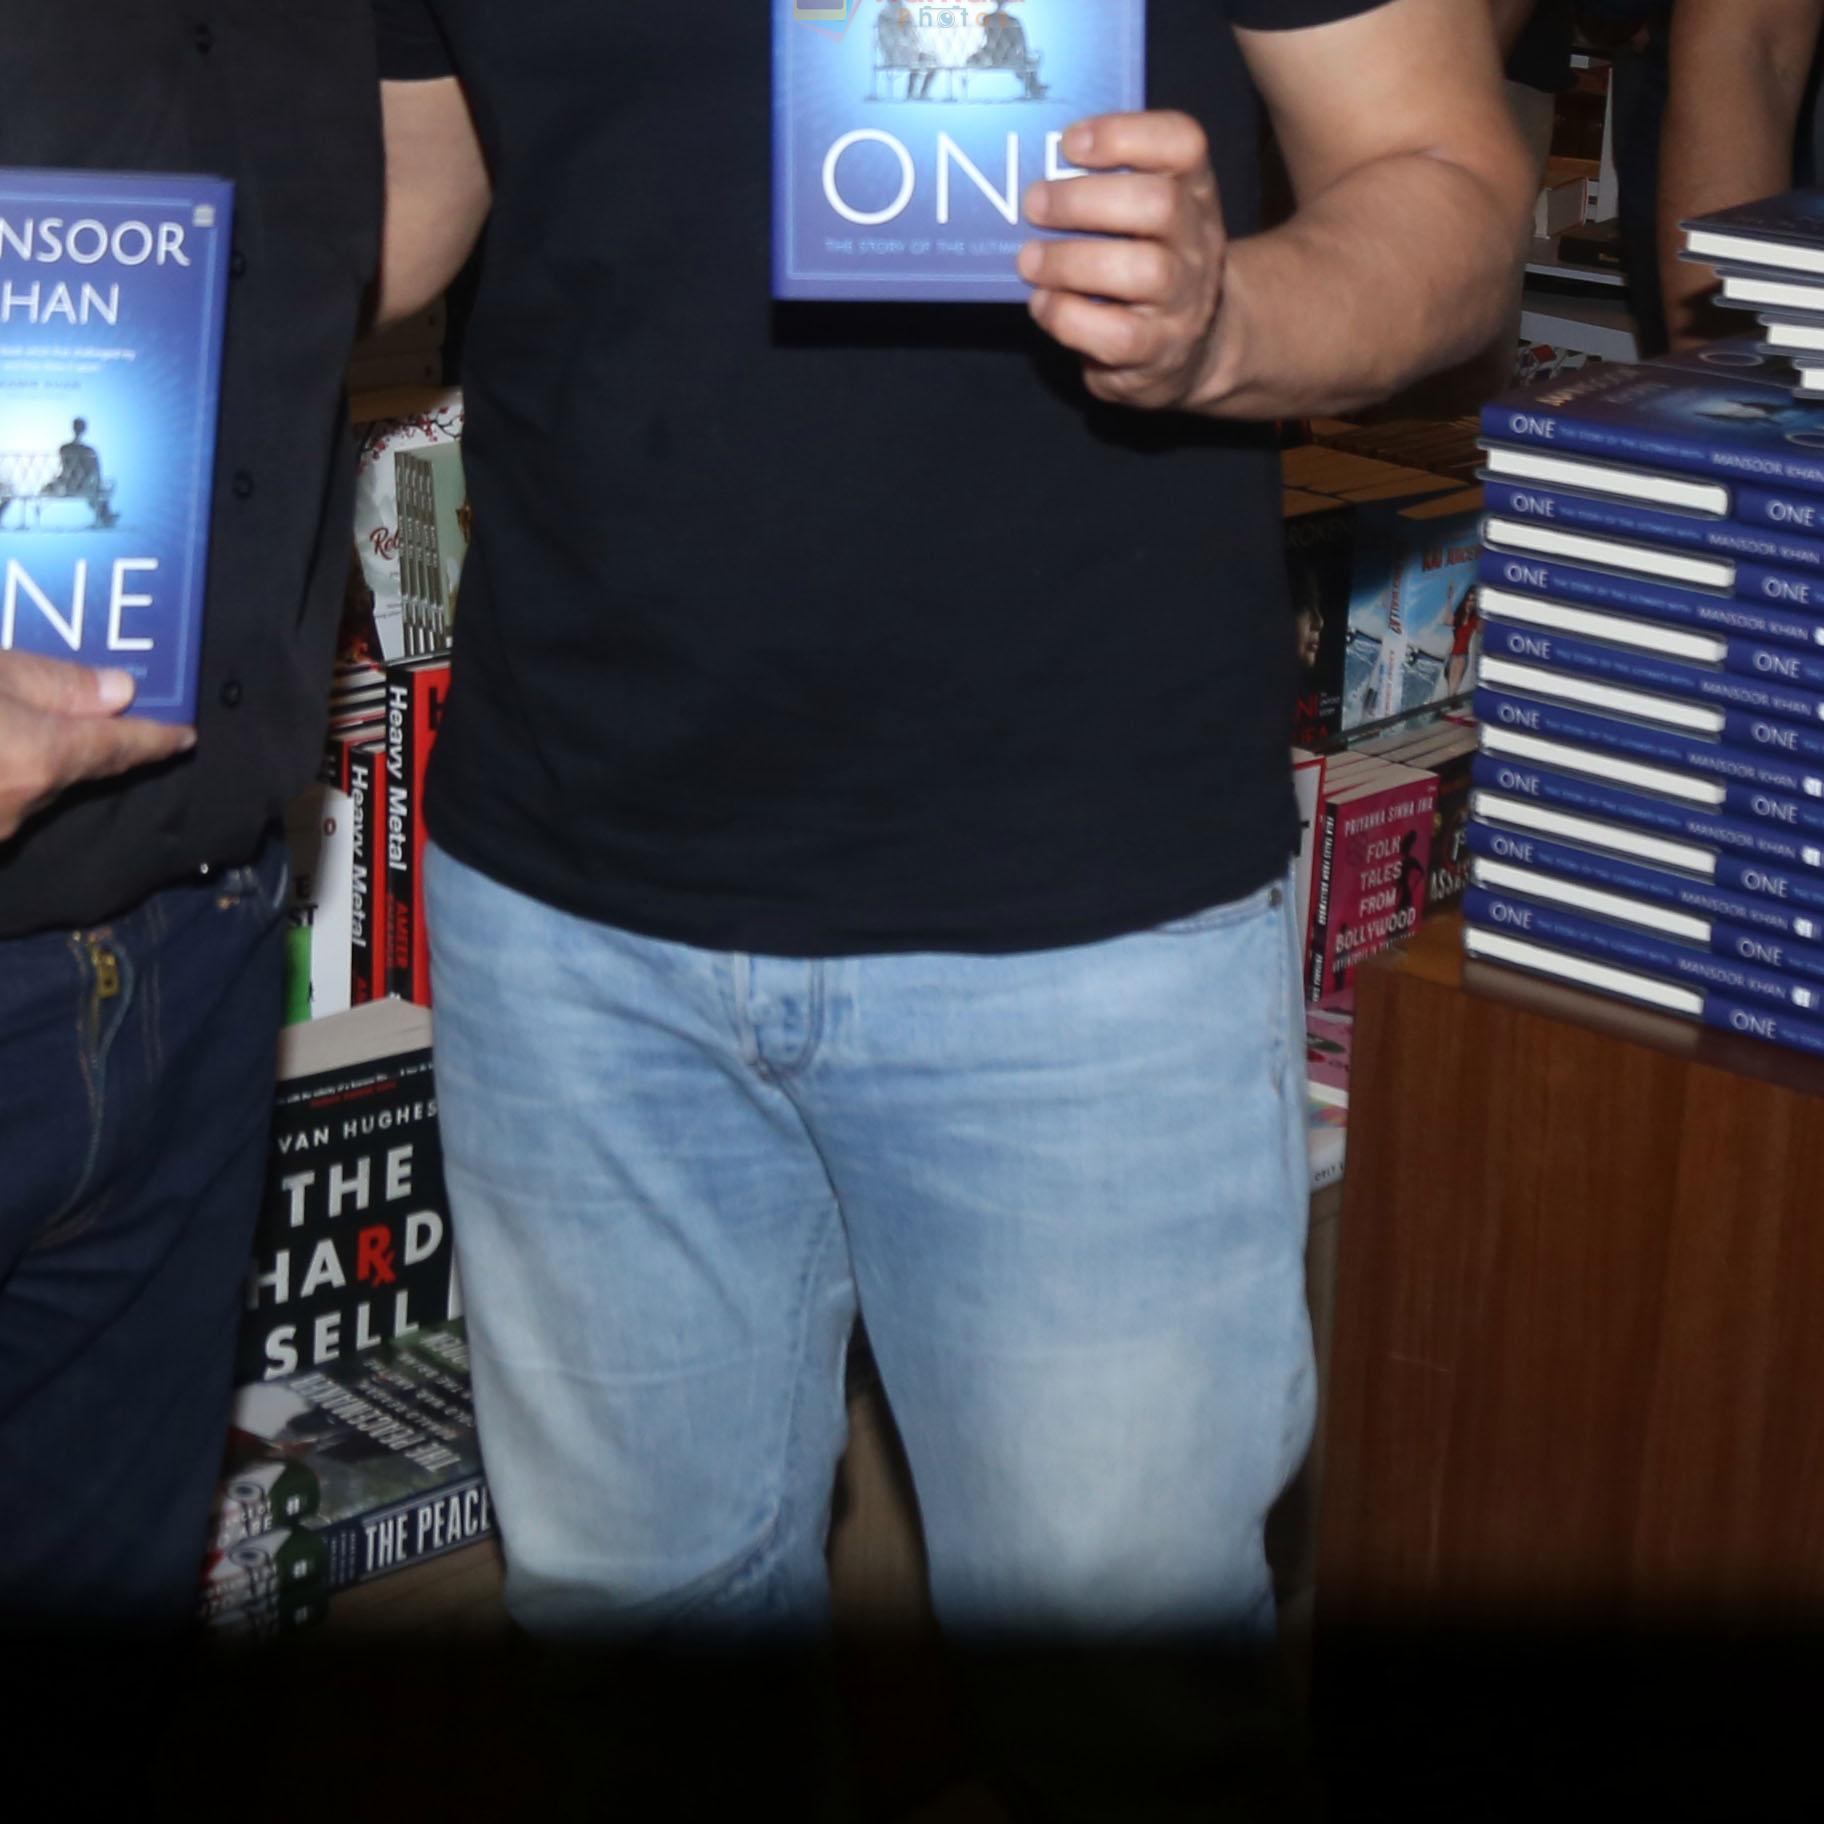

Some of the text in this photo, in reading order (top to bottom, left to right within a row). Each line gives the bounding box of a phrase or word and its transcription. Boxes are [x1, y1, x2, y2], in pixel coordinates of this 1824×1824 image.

[1509, 412, 1556, 440] ONE
[1712, 450, 1782, 475] MANSOOR
[1509, 492, 1821, 565] ONE MANSOOR KHAN
[1765, 498, 1816, 527] ONE
[1504, 562, 1809, 641] ONE MANSOOR KHAN
[1762, 578, 1811, 605] ONE
[1507, 633, 1812, 716] ONE MANSOOR KHAN
[1752, 650, 1801, 678] ONE
[1497, 702, 1798, 791] ONE MANSOOR KHAN
[1752, 722, 1799, 751] ONE
[388, 684, 408, 872] Heavy Metal
[1497, 768, 1540, 796] ONE
[1687, 820, 1755, 846] MANSOOR
[1757, 836, 1797, 860] KHAN
[1751, 796, 1798, 825] ONE
[350, 764, 369, 948] Heavy Metal
[1360, 860, 1404, 891] TALES
[1366, 834, 1403, 864] FOLK
[1358, 886, 1397, 919] FROM
[1490, 835, 1534, 864] ONE
[1680, 890, 1748, 918] MANSOOR
[1750, 906, 1789, 932] KHAN
[1741, 869, 1788, 900] ONE
[1334, 906, 1418, 954] BOLLYWOOD
[1489, 900, 1533, 930] ONE
[1678, 958, 1746, 987] MANSOOR
[1748, 975, 1787, 1000] KHAN
[1735, 937, 1783, 968] ONE
[1730, 1008, 1778, 1040] ONE
[278, 1100, 438, 1155] VAN HUGHES
[281, 1143, 414, 1228] THE
[245, 1208, 444, 1311] HARD
[263, 1288, 420, 1381] SELL
[364, 1514, 410, 1573] THE
